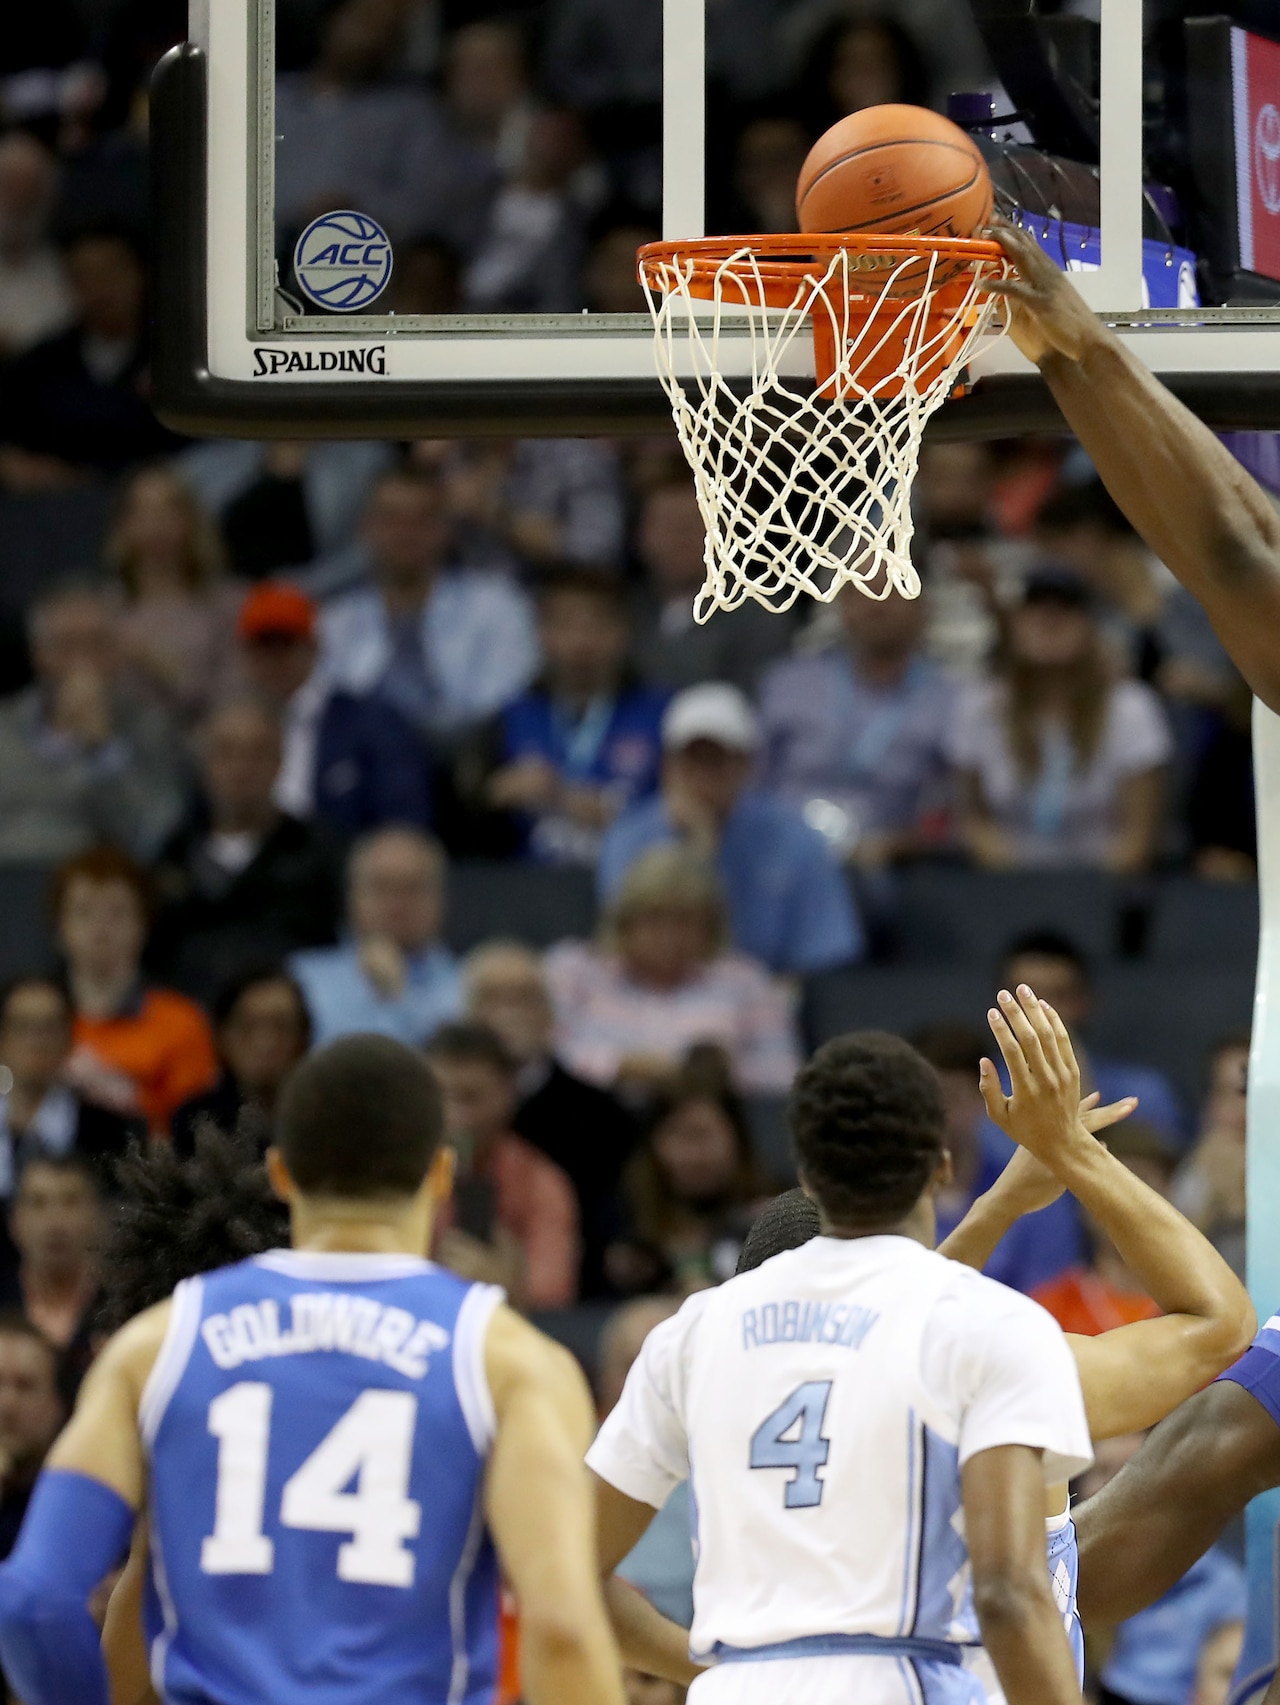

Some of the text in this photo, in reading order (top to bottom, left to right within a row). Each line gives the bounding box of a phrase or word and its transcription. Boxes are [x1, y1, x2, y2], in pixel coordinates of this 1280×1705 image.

[307, 243, 389, 265] ACC
[253, 345, 386, 377] SPALDING
[201, 1292, 449, 1381] GOLDWIRE
[742, 1299, 880, 1351] ROBINSON
[749, 1379, 833, 1509] 4
[200, 1380, 423, 1589] 14
